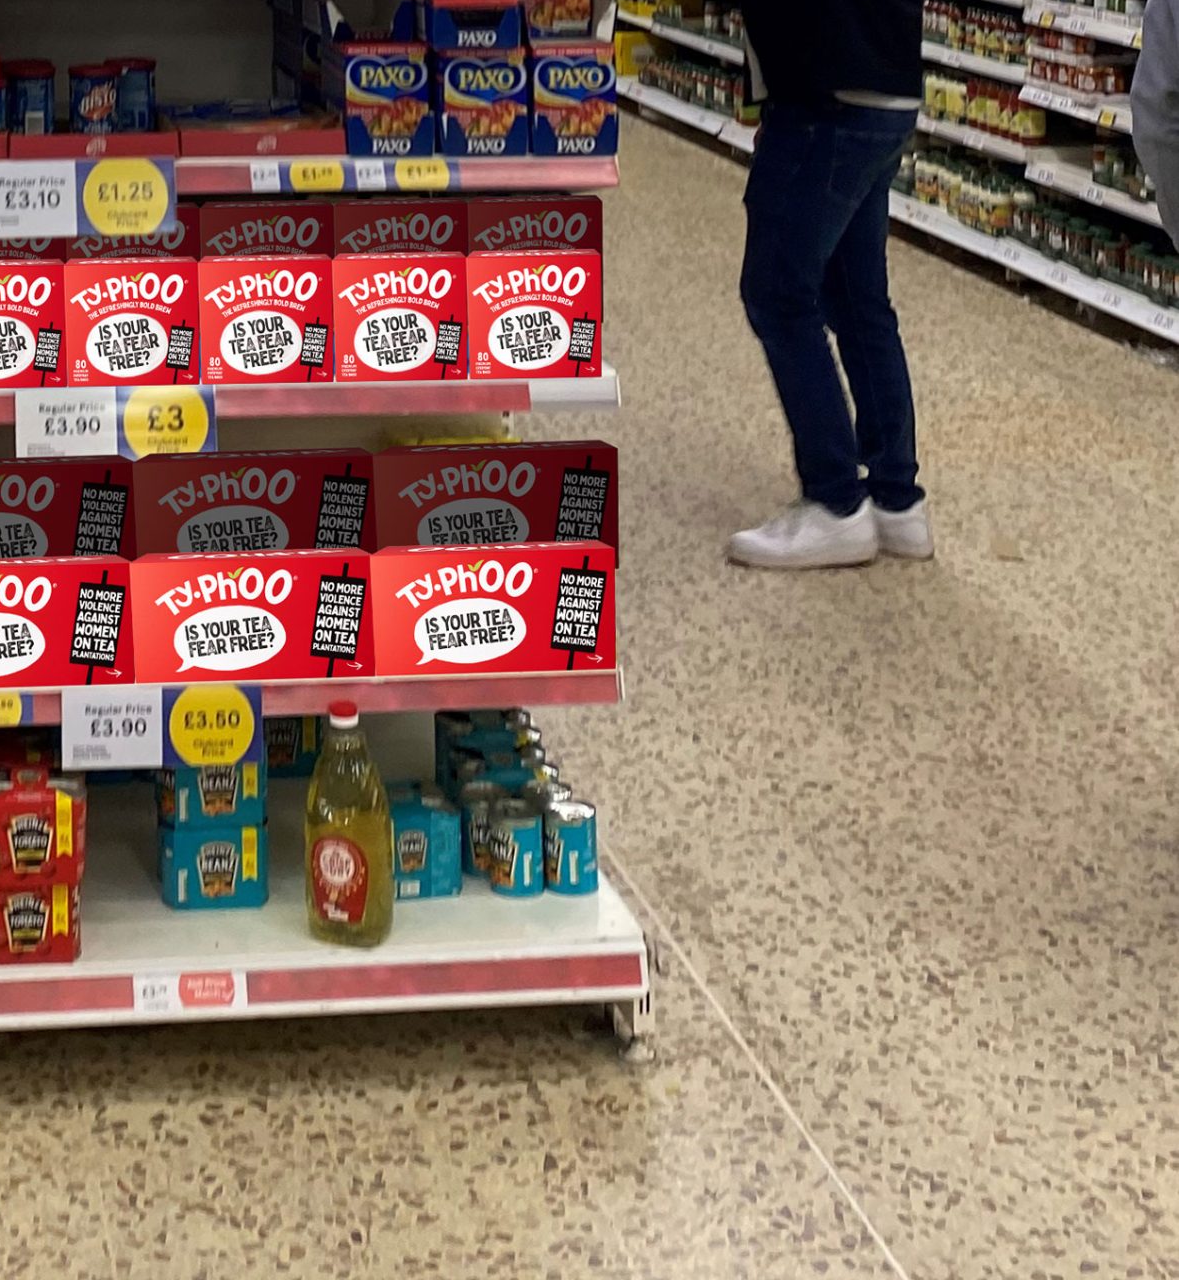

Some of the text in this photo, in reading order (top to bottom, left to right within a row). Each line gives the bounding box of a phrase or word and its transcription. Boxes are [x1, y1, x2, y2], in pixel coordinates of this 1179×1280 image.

[457, 30, 497, 48] PAXO
[360, 65, 415, 90] PAXO
[548, 65, 604, 89] PAXO
[372, 137, 411, 156] PAXO
[556, 136, 595, 154] PAXO
[4, 191, 61, 210] £3.10
[500, 310, 553, 333] IS YOUR
[497, 326, 562, 349] TEA FEAR
[477, 352, 489, 361] 80
[511, 343, 553, 365] FREE?
[44, 415, 101, 437] £3.90
[147, 404, 185, 433] £3
[80, 588, 123, 602] NO MORE
[79, 600, 121, 614] VIOLENCE
[77, 612, 120, 624] AGAINST
[2, 624, 32, 640] TEA
[75, 622, 118, 638] WOMEN
[185, 616, 273, 641] IS YOUR TEA
[74, 636, 115, 652] ON TEA
[188, 632, 276, 658] FEAR FREE?
[72, 650, 115, 662] PLANTATIONS
[90, 718, 147, 738] £3.90
